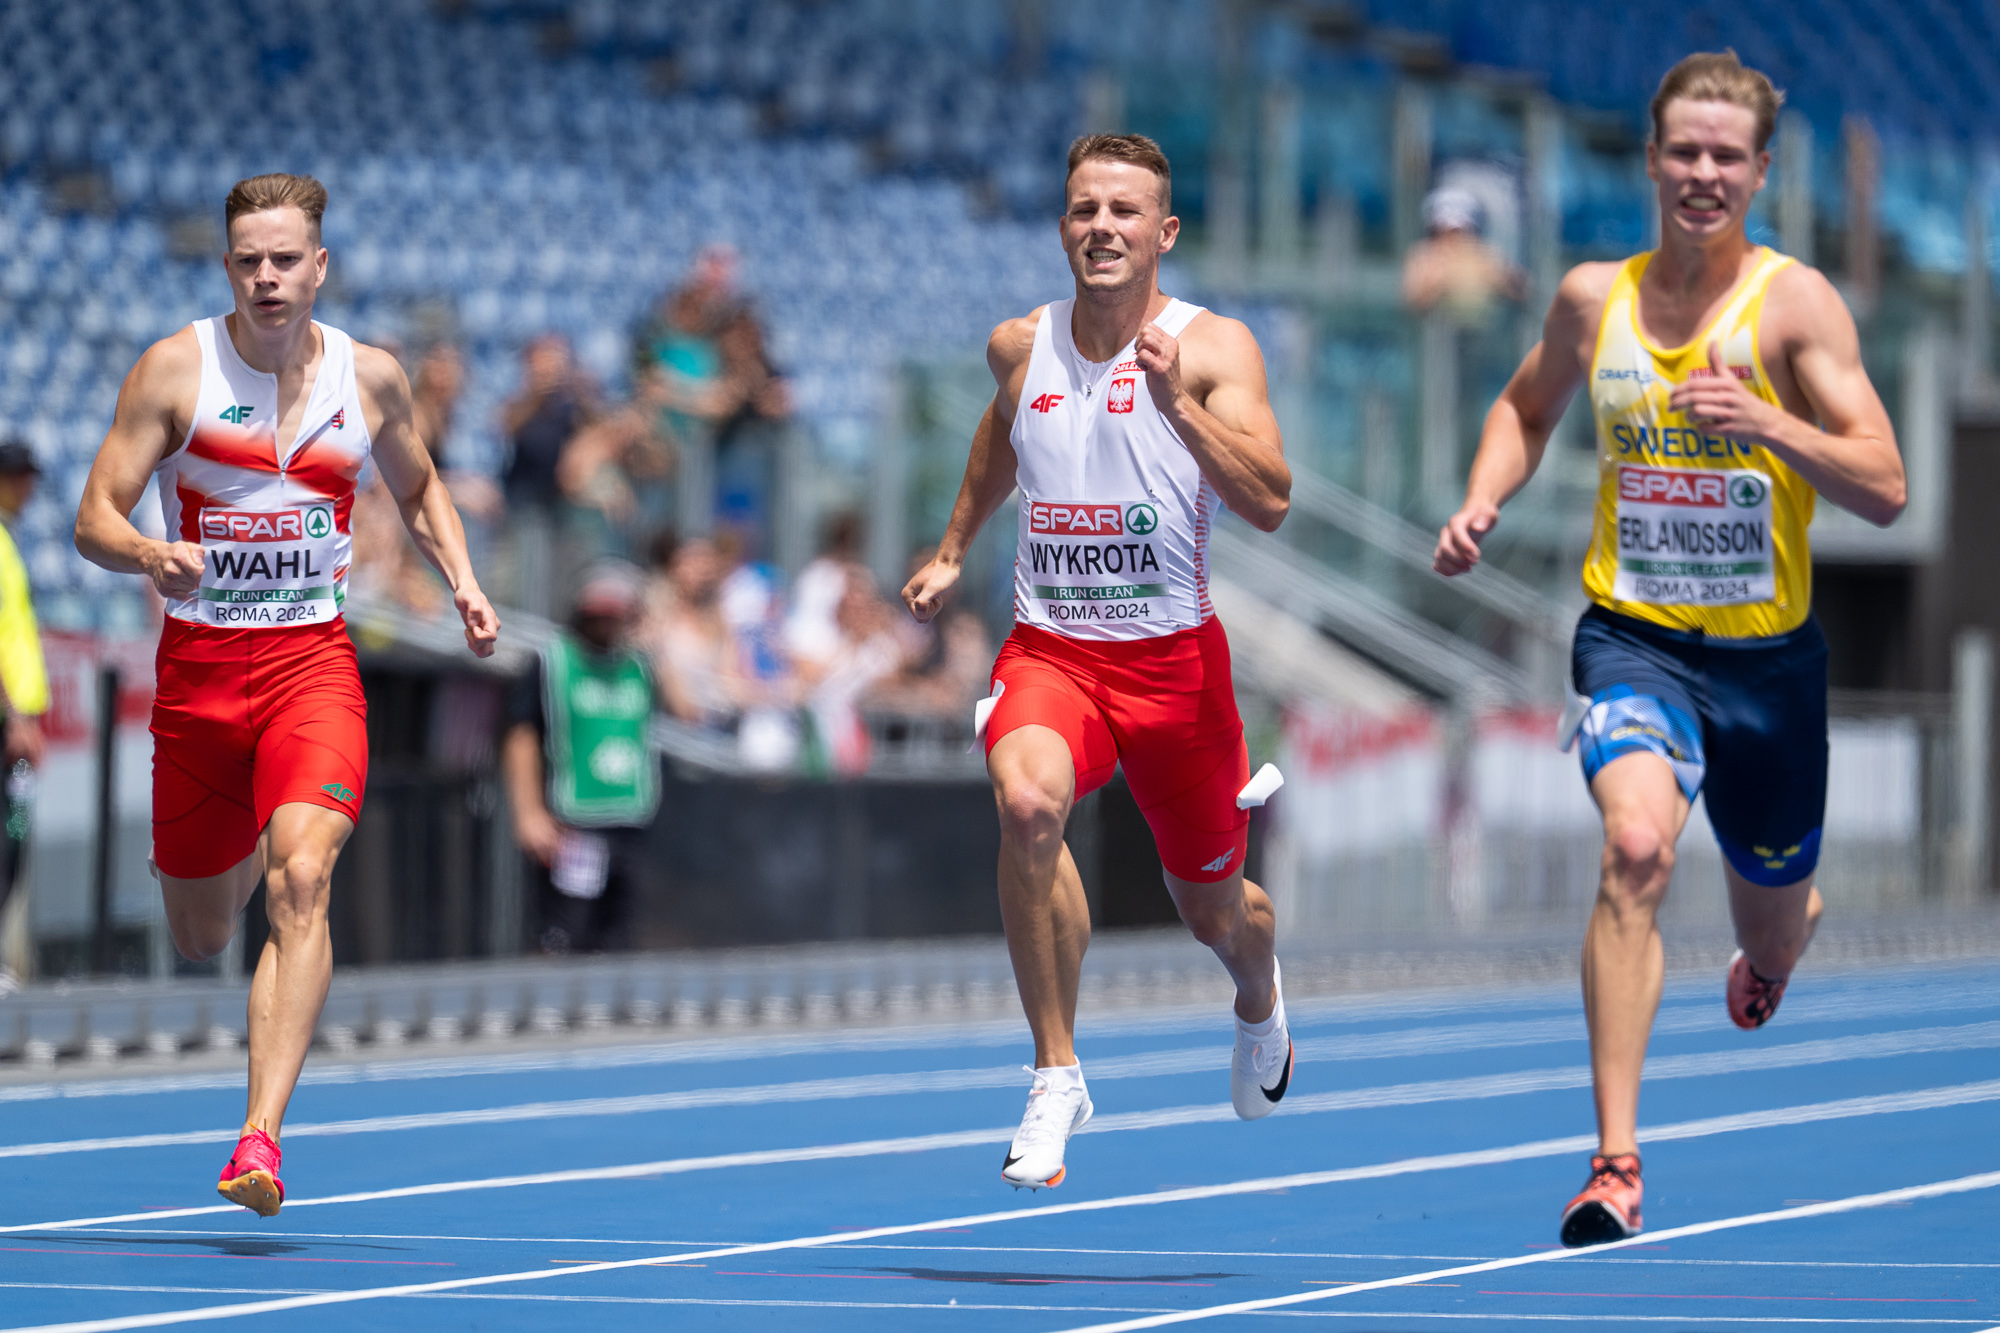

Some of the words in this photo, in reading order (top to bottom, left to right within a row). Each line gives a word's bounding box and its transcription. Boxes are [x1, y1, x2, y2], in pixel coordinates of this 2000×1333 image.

[1112, 361, 1141, 374] ORLE
[1597, 368, 1639, 381] CRAFT
[1030, 393, 1064, 413] 4F
[219, 405, 254, 424] 4F
[1613, 424, 1752, 458] SWEDEN
[1620, 471, 1723, 504] SPAR
[204, 514, 300, 538] SPAR
[1032, 506, 1121, 531] SPAR
[1619, 516, 1764, 556] ERLANDSSON
[210, 549, 321, 580] WAHL
[1030, 542, 1160, 575] WYKROTA
[232, 591, 260, 601] RUN
[1059, 587, 1087, 599] RUN
[1635, 577, 1695, 600] ROMA
[1700, 579, 1749, 600] 2024
[215, 607, 271, 622] ROMA
[276, 605, 317, 622] 2024
[1048, 604, 1101, 620] ROMA
[1105, 602, 1150, 620] 2024
[321, 783, 357, 802] 4F
[1200, 846, 1236, 872] 4F
